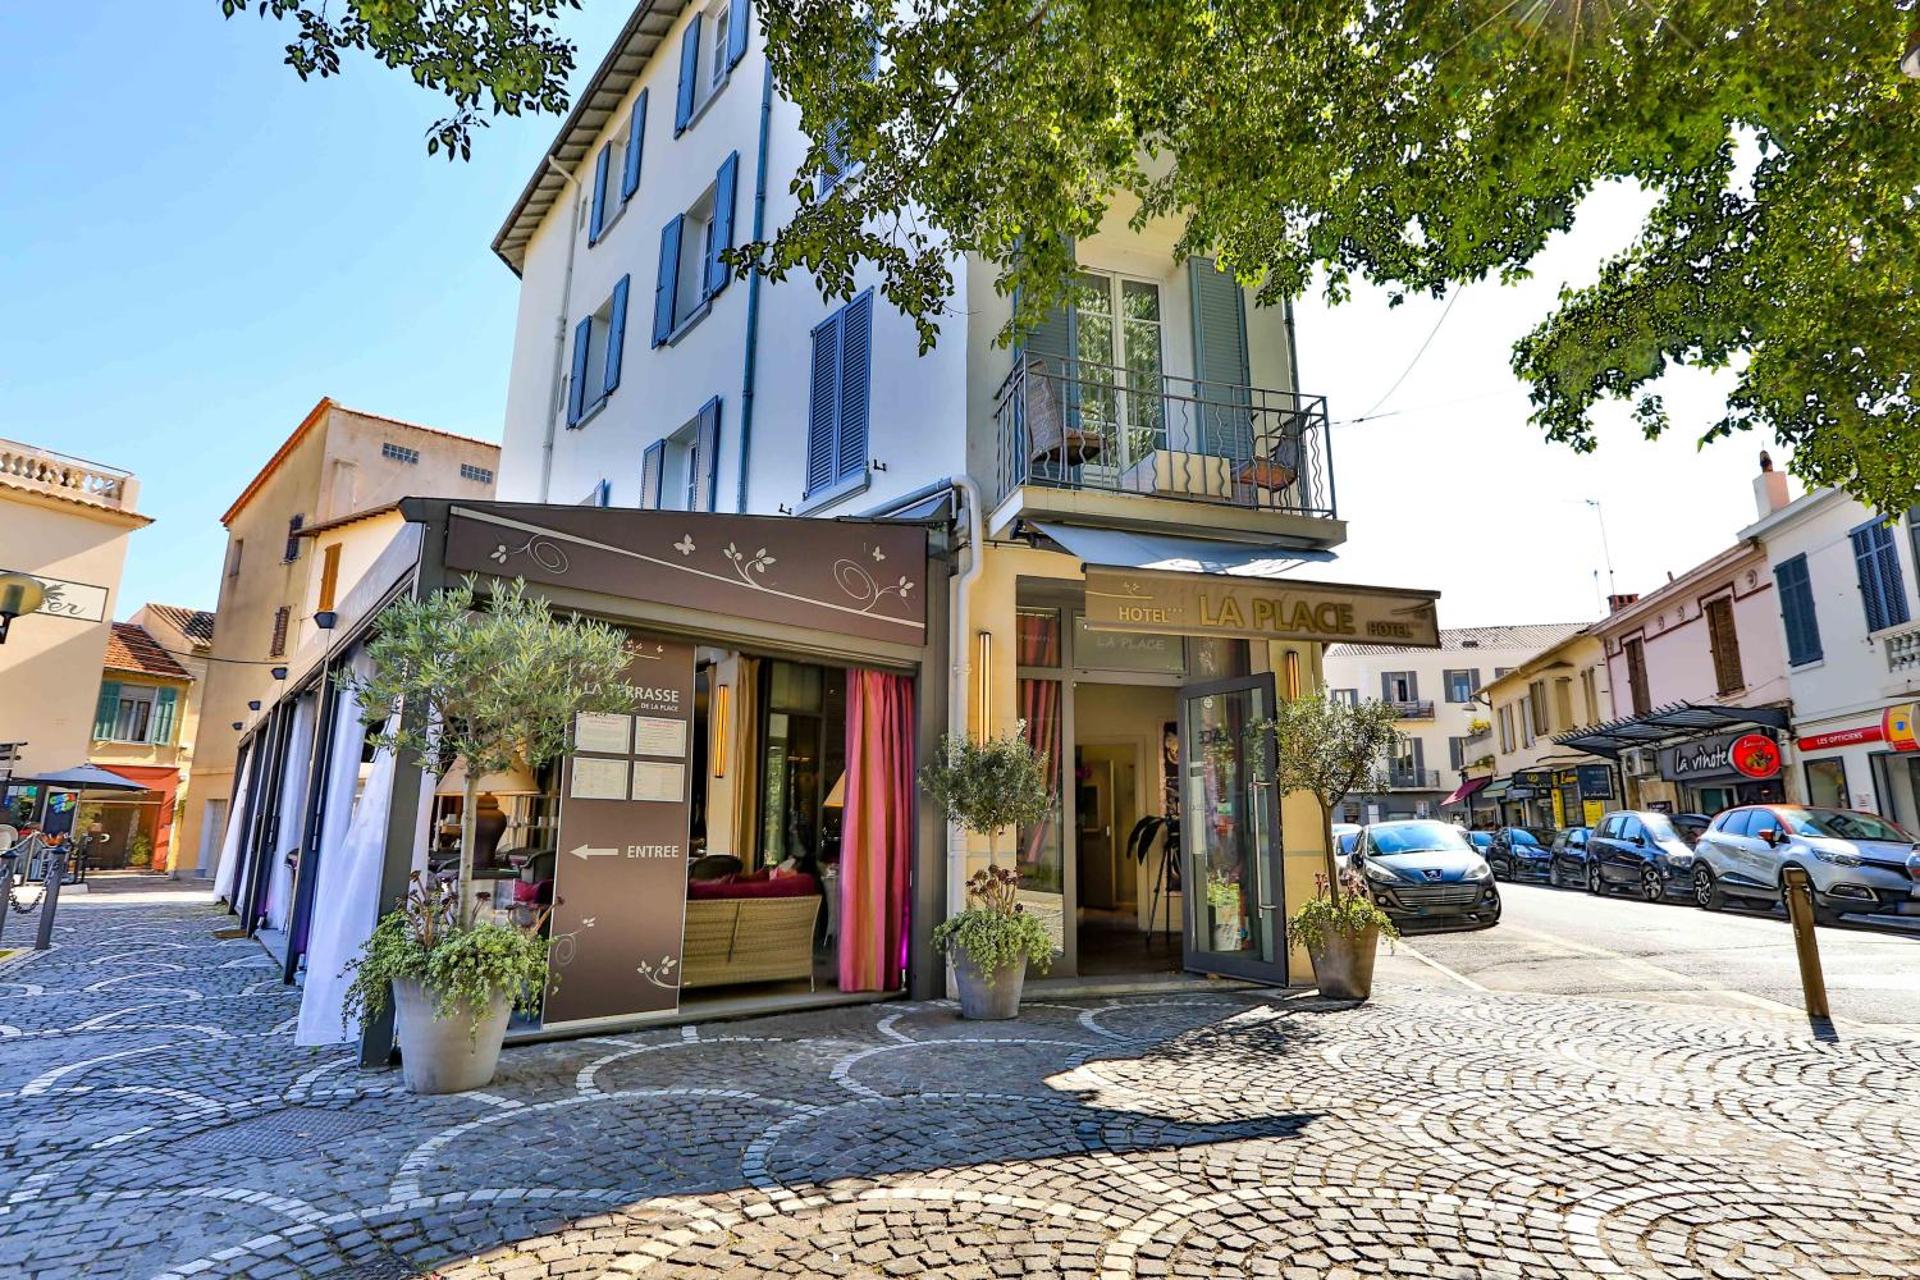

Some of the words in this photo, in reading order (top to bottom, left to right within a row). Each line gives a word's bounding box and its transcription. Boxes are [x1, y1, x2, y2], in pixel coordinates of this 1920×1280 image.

[1118, 606, 1169, 623] HOTEL
[1199, 594, 1245, 628] LA
[1252, 597, 1357, 635] PLACE
[1366, 621, 1414, 638] HOTEL
[1096, 637, 1114, 648] LA
[1121, 637, 1165, 650] PLACE
[584, 681, 603, 695] LA
[660, 704, 679, 712] PLACE
[627, 845, 680, 858] ENTREE
